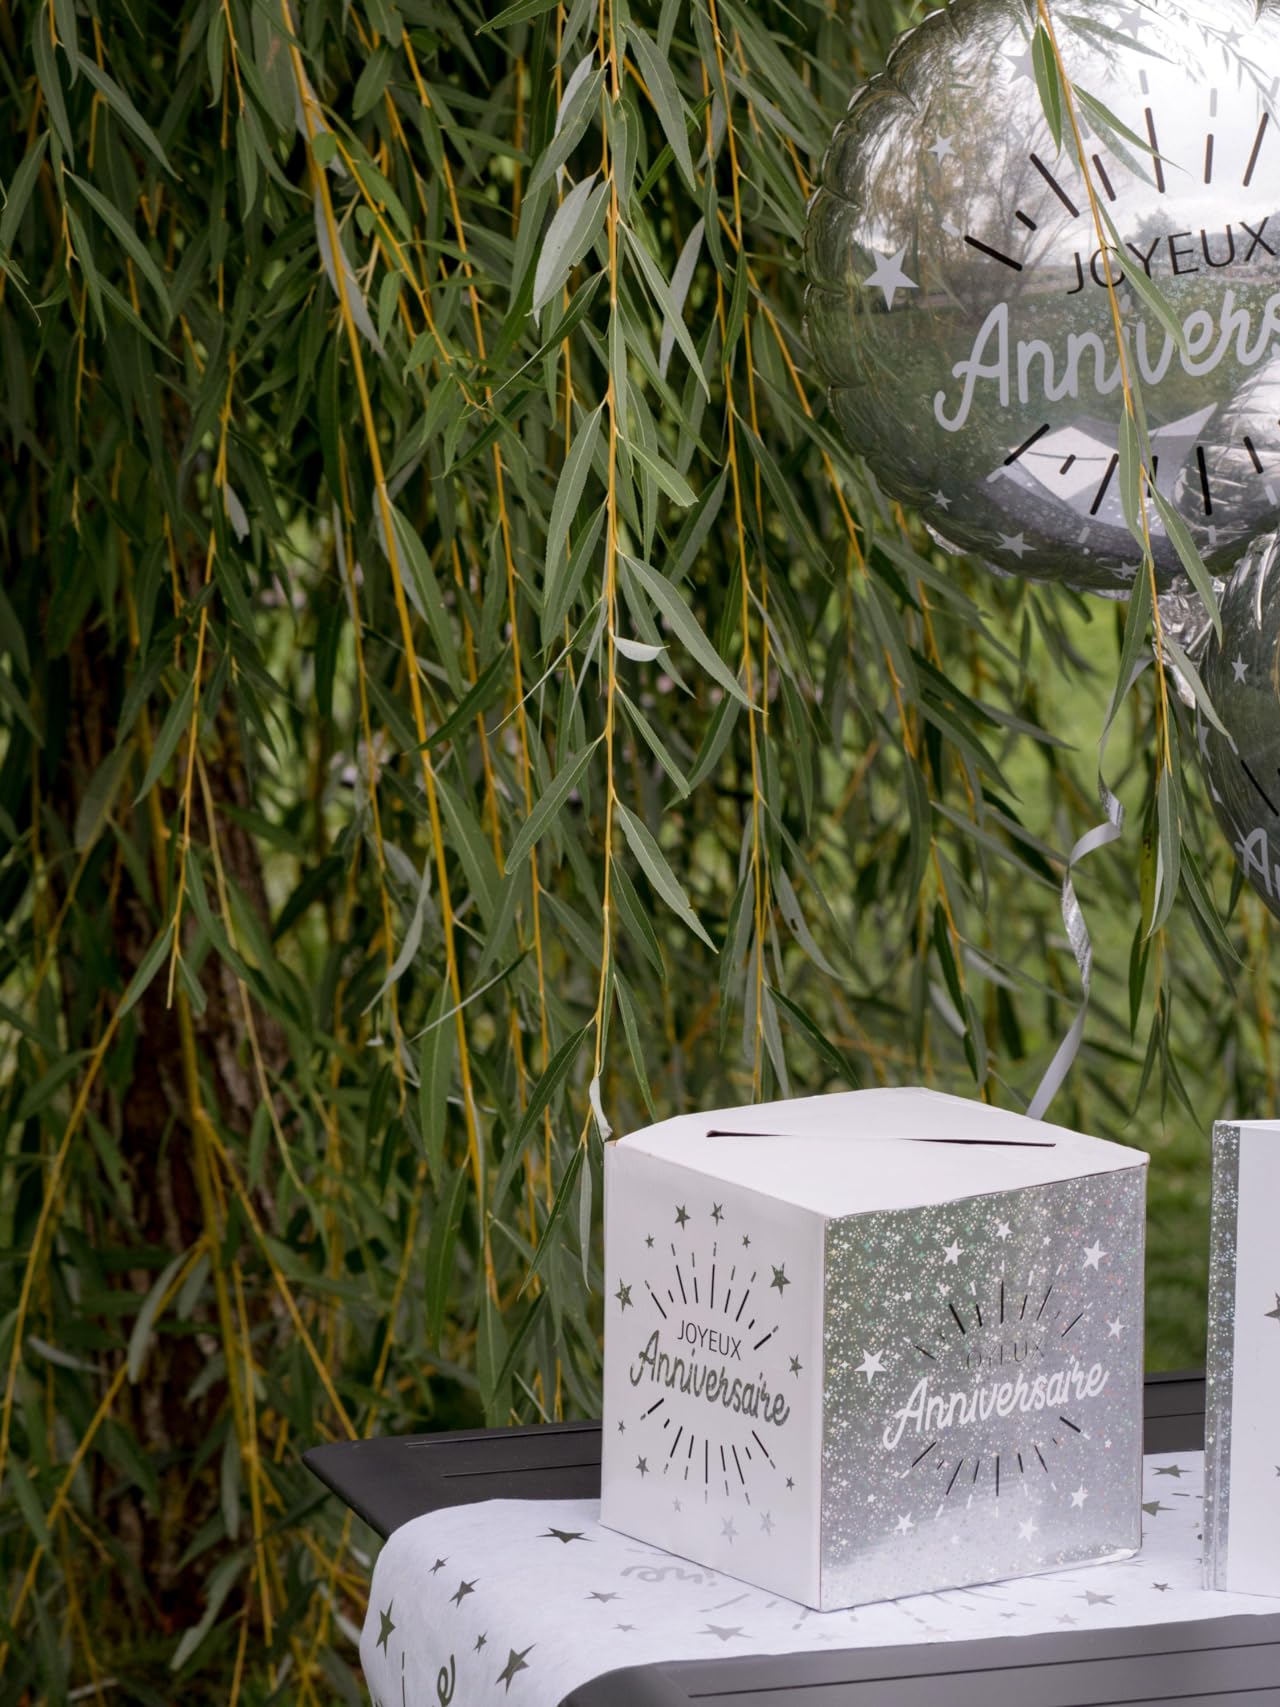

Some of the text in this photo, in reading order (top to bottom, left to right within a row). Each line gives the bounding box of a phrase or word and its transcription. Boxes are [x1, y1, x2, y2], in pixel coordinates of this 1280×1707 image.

[1066, 216, 1277, 295] JOYEUX
[629, 1329, 790, 1427] Anniversaire
[677, 1318, 742, 1361] JOYEUX
[883, 1354, 1110, 1451] Anniversaire
